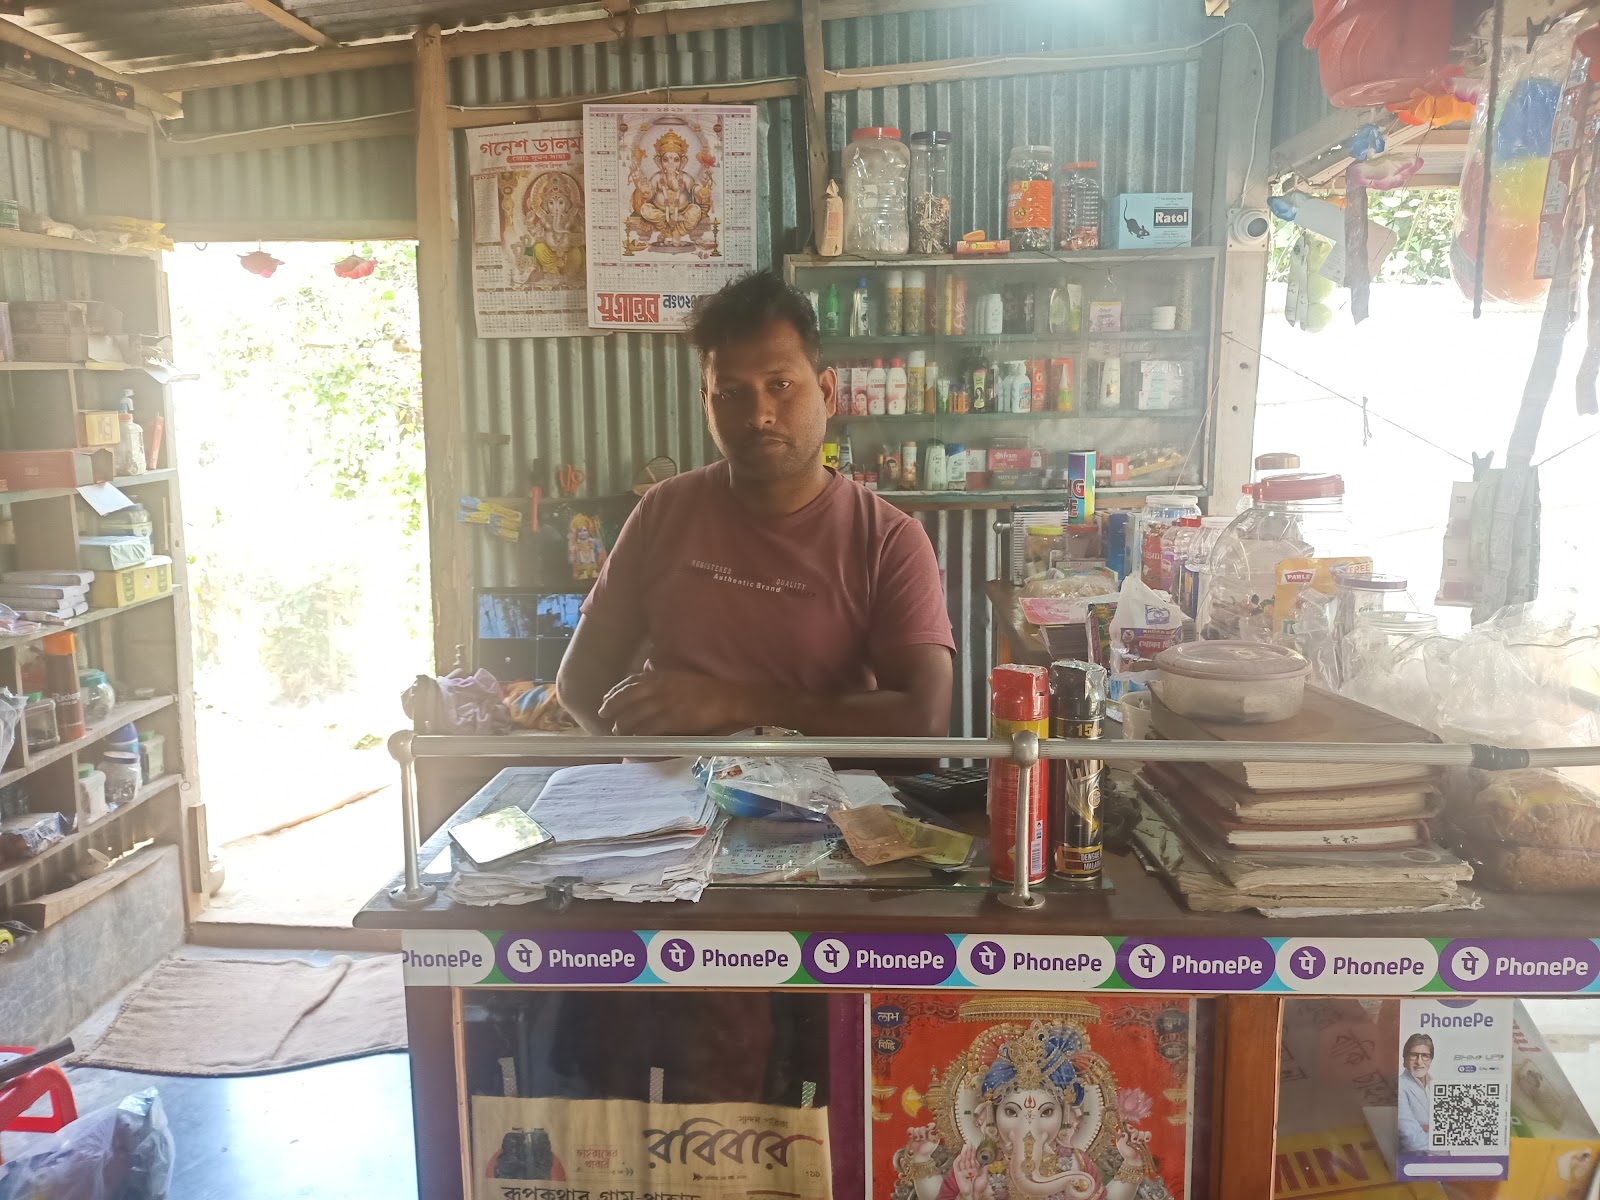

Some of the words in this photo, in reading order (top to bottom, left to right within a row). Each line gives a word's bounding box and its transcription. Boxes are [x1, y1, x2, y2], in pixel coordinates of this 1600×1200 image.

[1155, 211, 1188, 224] Ratol
[691, 559, 732, 575] REGISTERED
[1349, 563, 1371, 574] FREE
[713, 573, 754, 588] Authentic
[756, 582, 782, 593] Brand
[775, 578, 807, 591] QUALITY
[1286, 573, 1311, 581] PARLE
[549, 949, 636, 968] PhonePe
[702, 949, 789, 968] PhonePe
[857, 950, 945, 970] PhonePe
[1014, 953, 1102, 972] PhonePe
[1172, 954, 1263, 975] PhonePe
[1334, 956, 1425, 976] PhonePe
[1496, 956, 1589, 976] PhonePe
[1421, 1012, 1494, 1028] PhonePe
[643, 1117, 824, 1170] রবিবার
